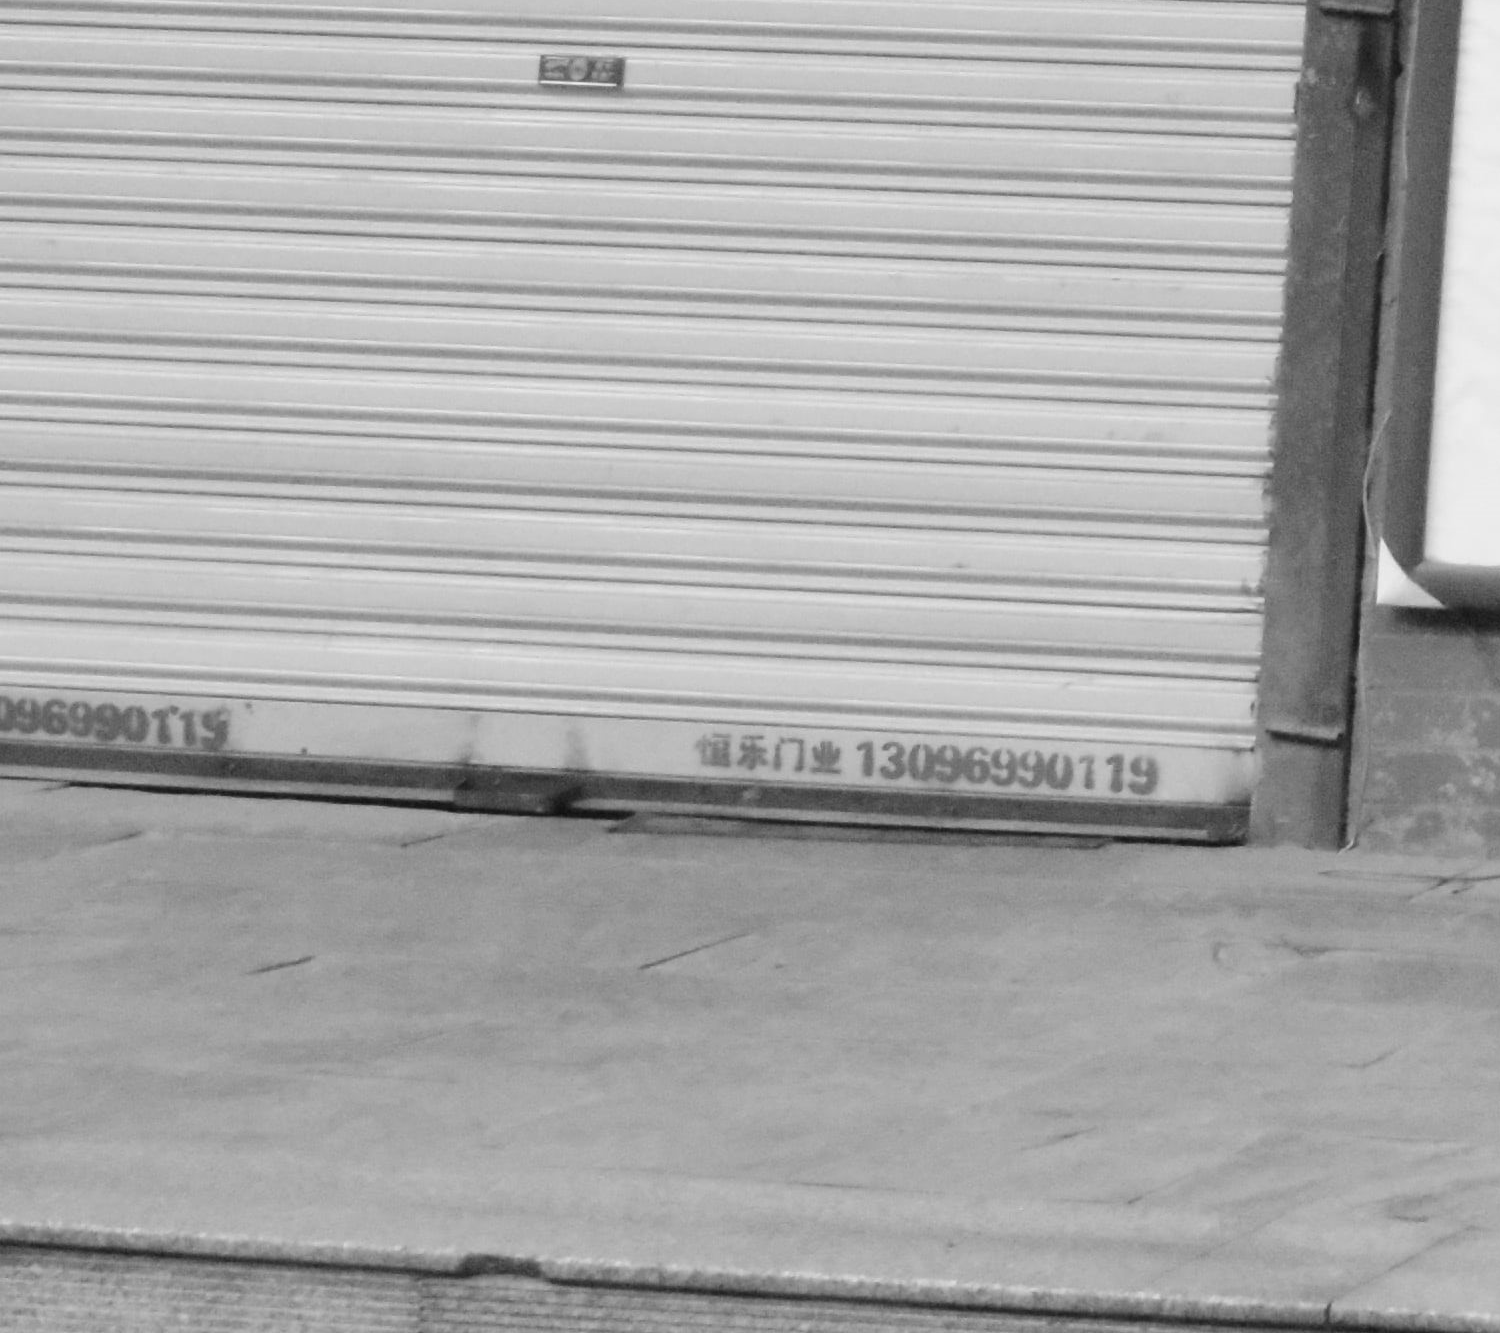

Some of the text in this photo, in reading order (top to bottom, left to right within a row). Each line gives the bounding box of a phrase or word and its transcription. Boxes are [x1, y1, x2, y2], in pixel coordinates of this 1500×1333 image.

[694, 731, 1160, 796] 恒乐门业 13096990119
